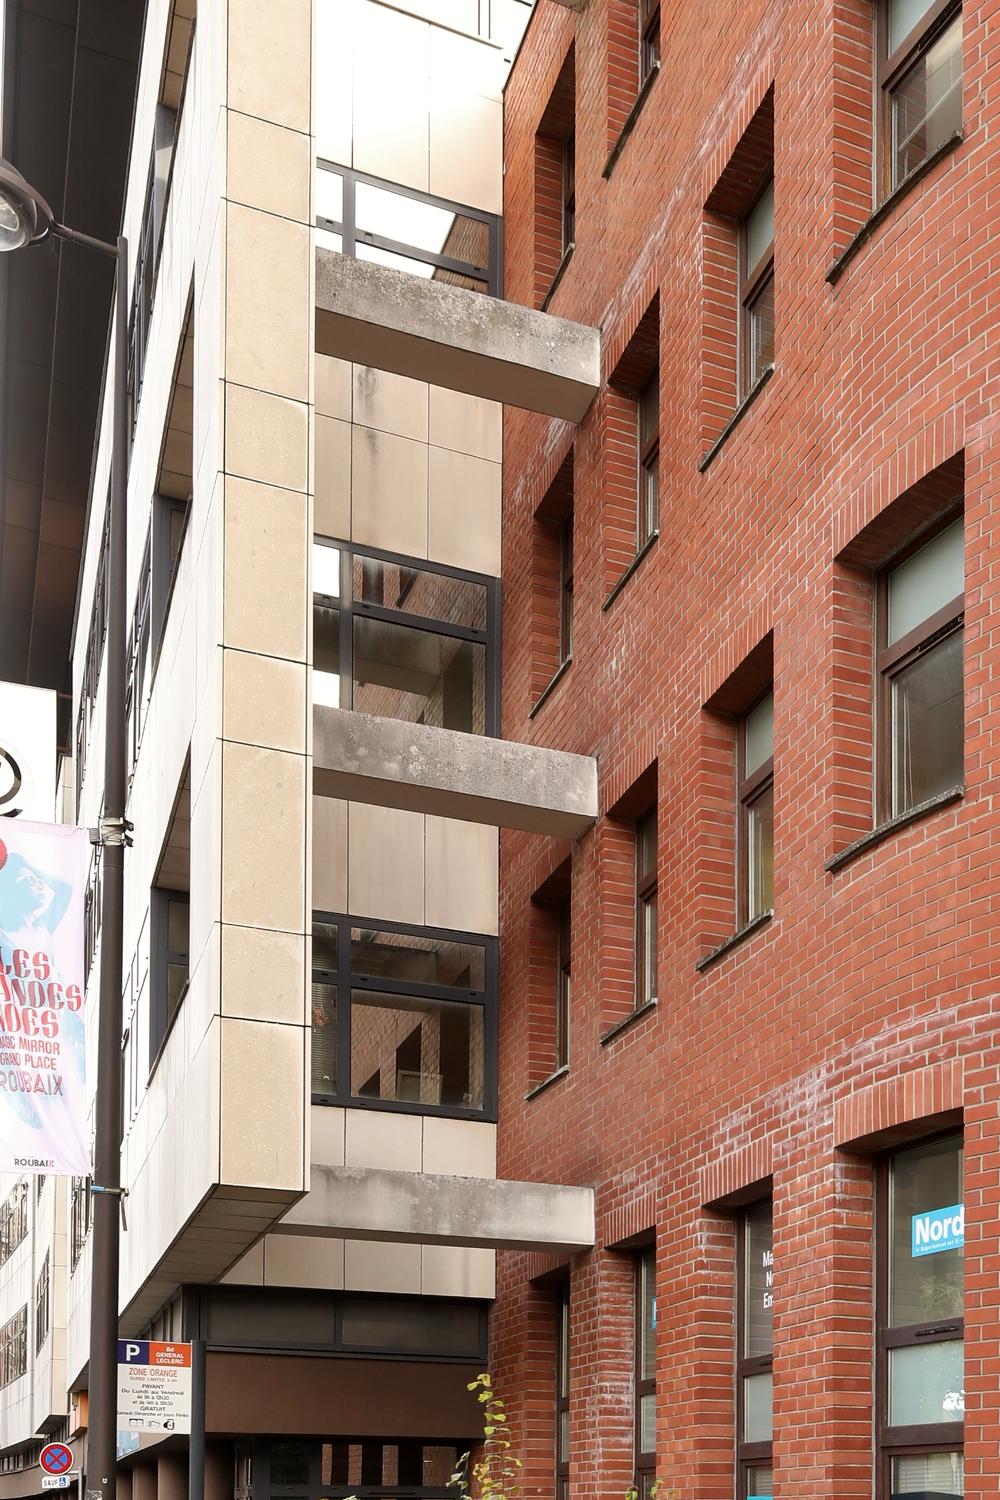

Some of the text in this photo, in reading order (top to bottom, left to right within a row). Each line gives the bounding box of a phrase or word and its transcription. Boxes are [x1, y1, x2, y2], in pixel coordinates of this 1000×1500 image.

[19, 1036, 60, 1056] MIRROR
[0, 1052, 57, 1071] GRAND PLACE
[14, 1158, 55, 1168] ROUBAIX
[915, 1206, 965, 1245] Nord
[126, 1344, 140, 1361] P
[128, 1368, 178, 1377] ZONE ORANGE
[43, 1479, 58, 1487] SAUF
